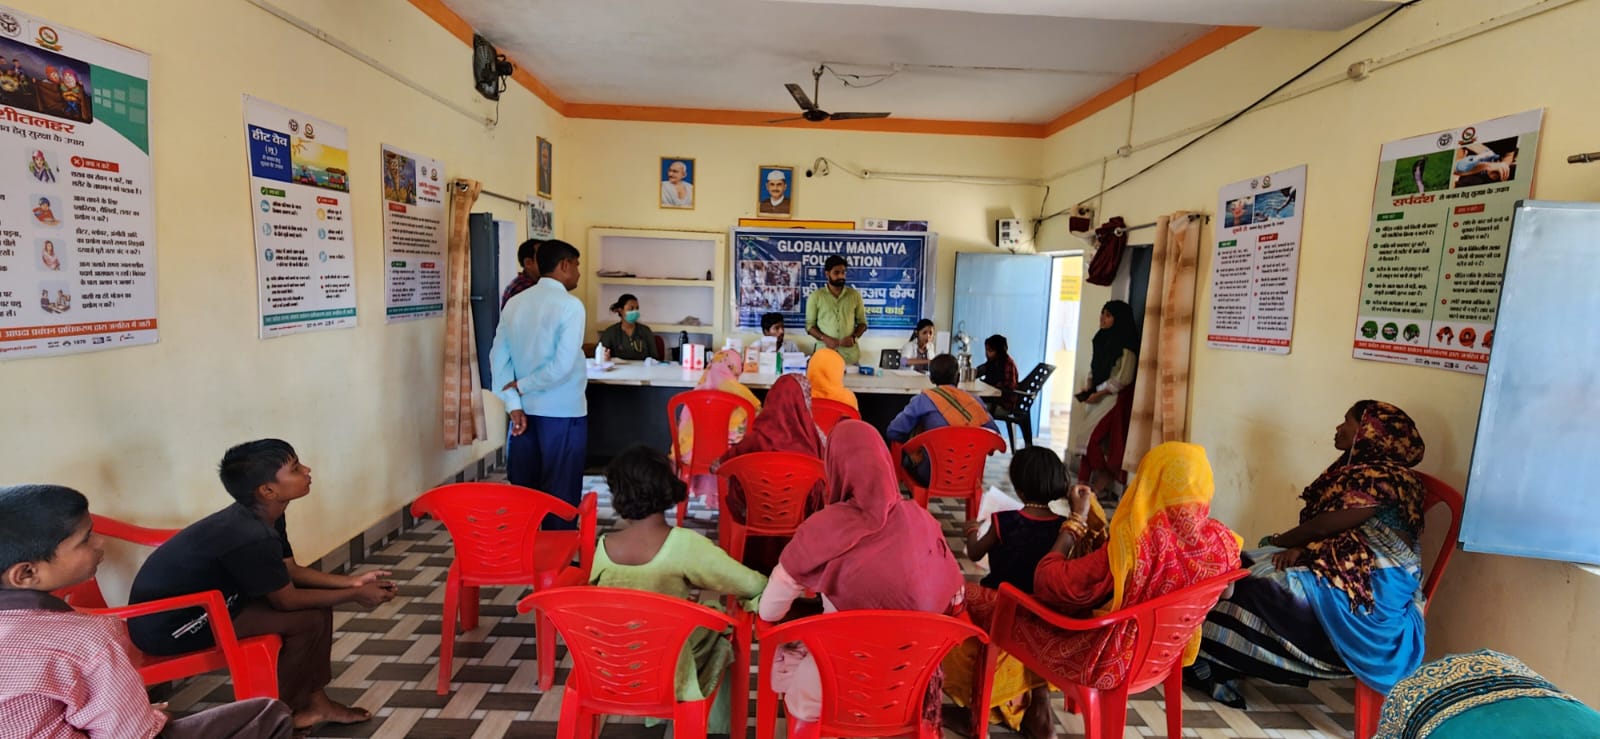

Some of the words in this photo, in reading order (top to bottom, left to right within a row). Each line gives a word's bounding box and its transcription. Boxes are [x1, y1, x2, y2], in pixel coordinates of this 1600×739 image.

[54, 134, 62, 142] के
[1392, 193, 1435, 207] सर्पदंश
[777, 239, 843, 254] GLOBALLY
[846, 240, 907, 255] MANAVYA
[802, 254, 882, 267] FOUATION
[889, 283, 916, 300] कैम्प
